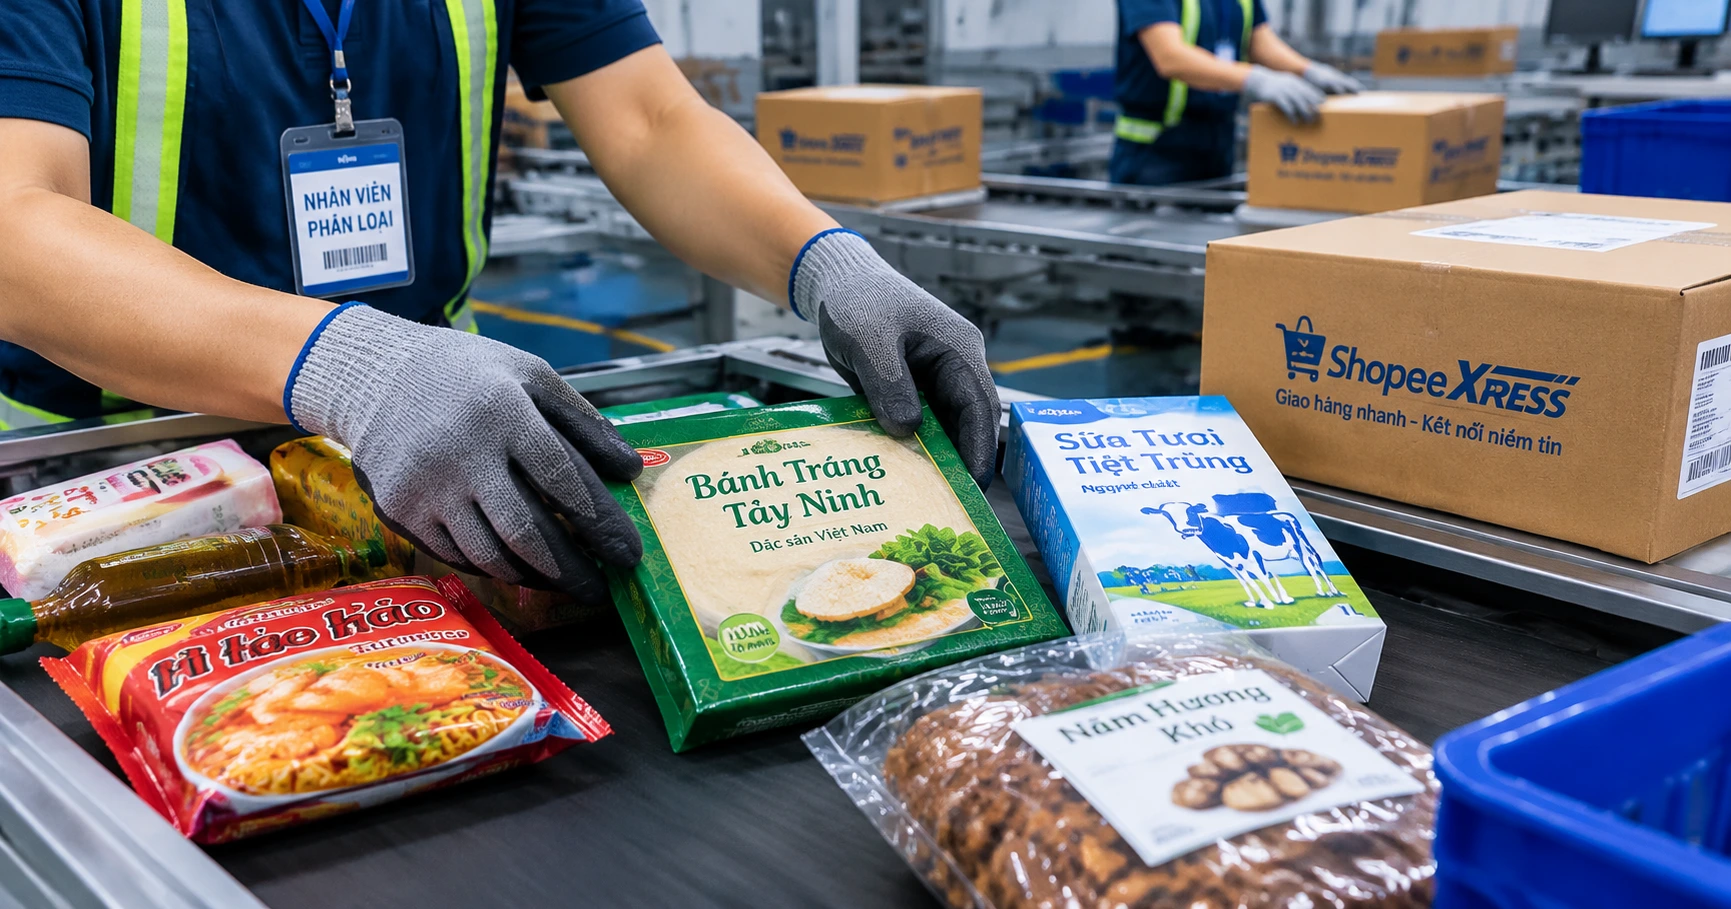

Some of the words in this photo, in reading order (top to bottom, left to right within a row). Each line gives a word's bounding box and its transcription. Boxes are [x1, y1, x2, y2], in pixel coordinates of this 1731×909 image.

[1326, 344, 1447, 398] Shopee
[1275, 388, 1311, 409] Giao
[1356, 403, 1407, 428] nhanh
[1538, 435, 1563, 456] tin
[684, 464, 785, 500] Bánh
[795, 483, 886, 518] Ninh
[850, 522, 888, 535] Nam
